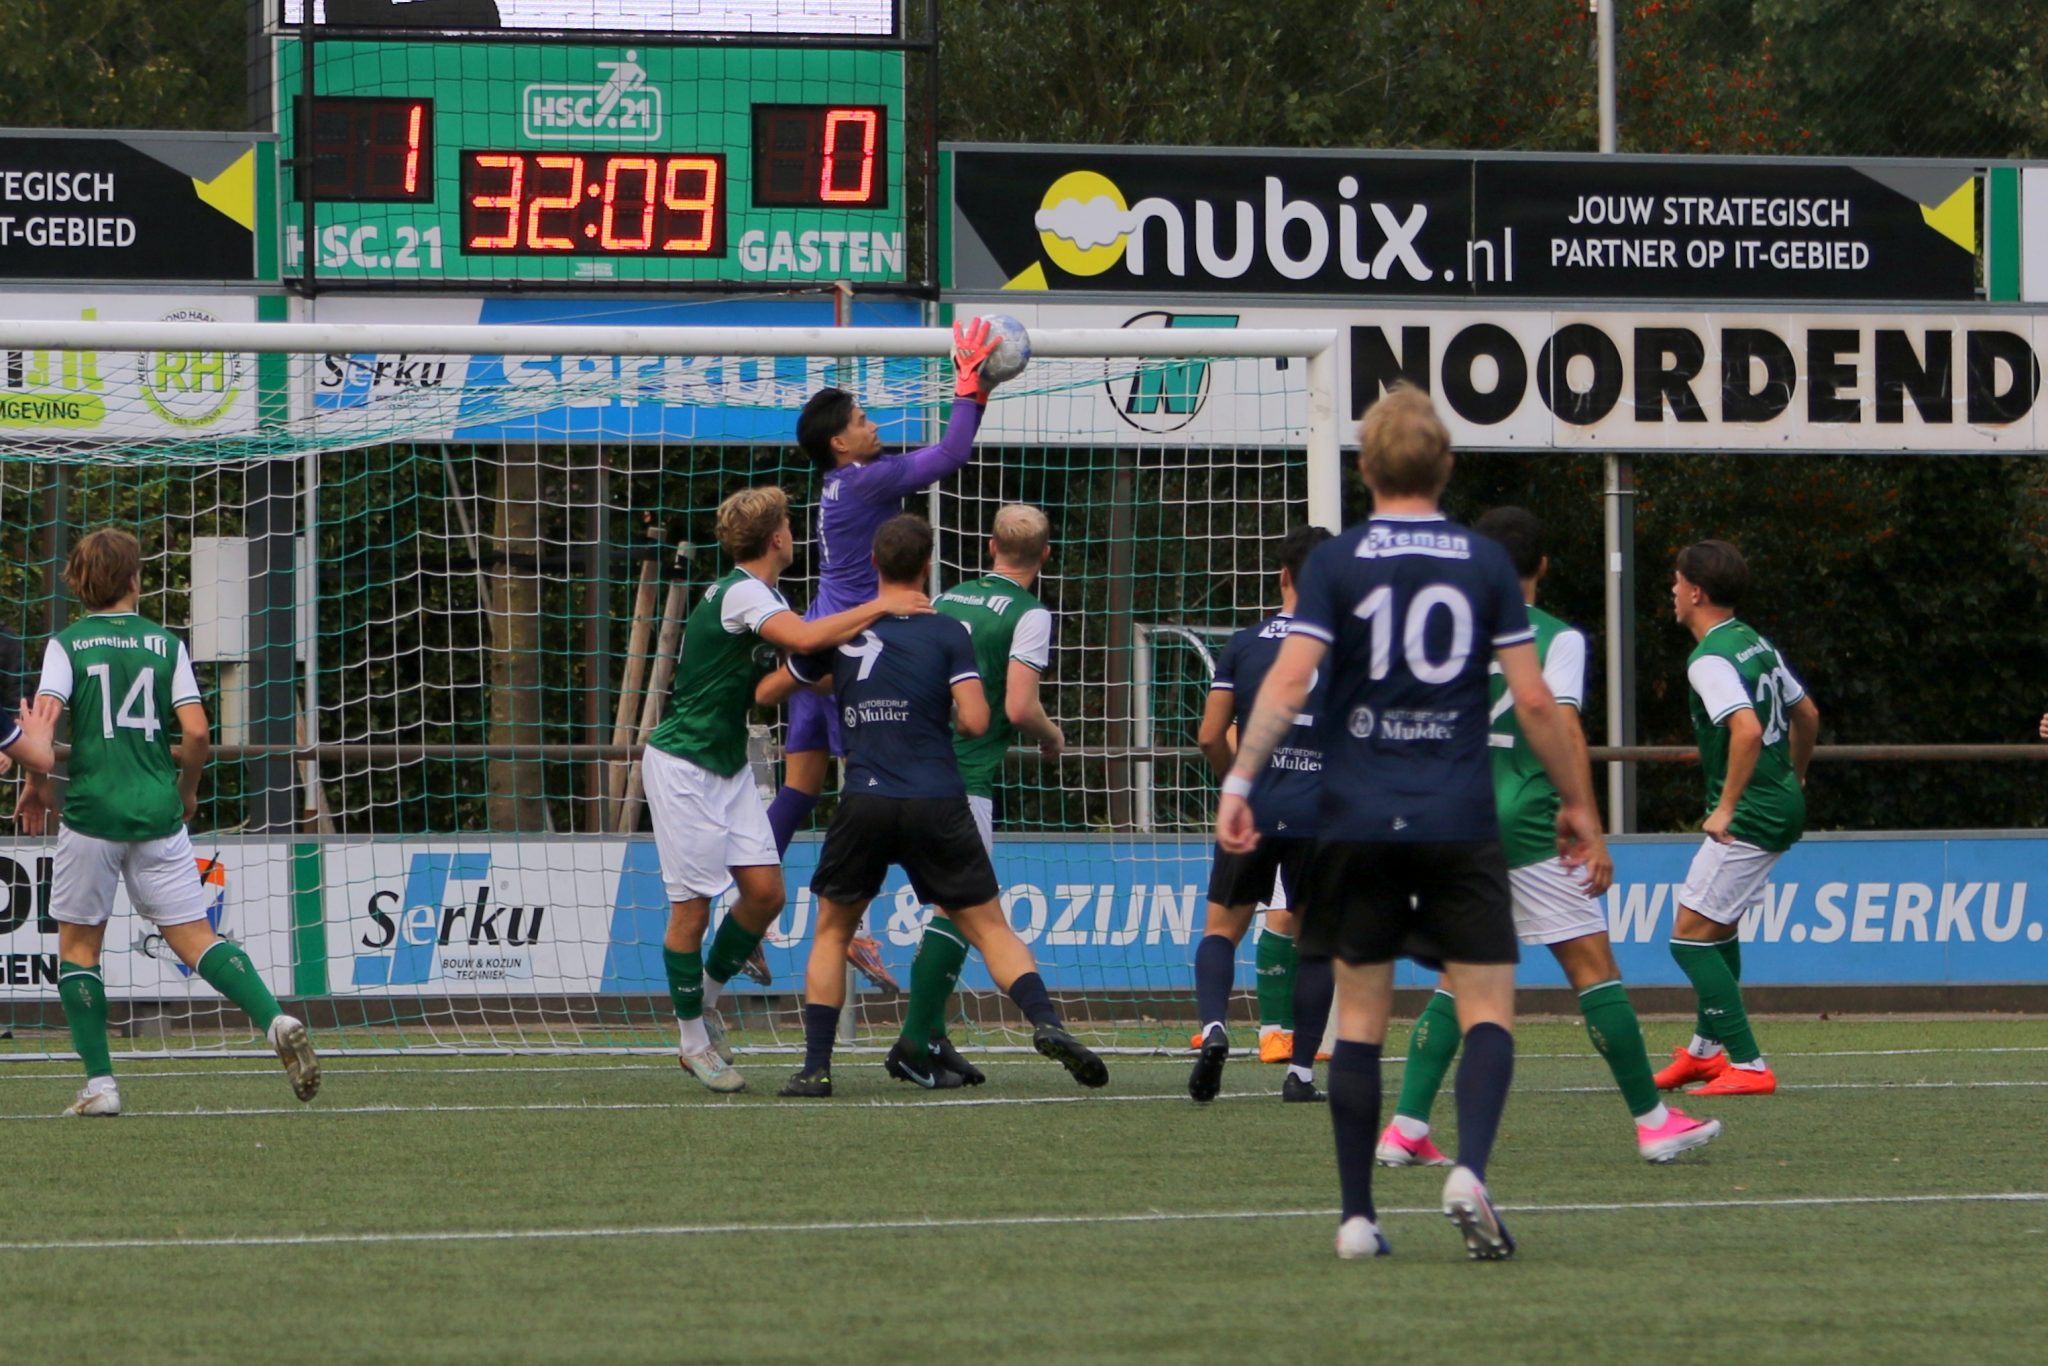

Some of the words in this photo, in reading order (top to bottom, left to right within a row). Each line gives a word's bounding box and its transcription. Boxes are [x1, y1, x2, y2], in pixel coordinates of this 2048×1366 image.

[403, 105, 423, 195] 1
[820, 109, 877, 203] 0
[0, 171, 115, 202] TEGISCH
[469, 155, 718, 252] 32:09
[1568, 195, 1655, 226] JOUW
[1663, 197, 1850, 229] STRATEGISCH
[286, 224, 443, 270] HSC.21
[737, 229, 902, 274] GASTEN
[1550, 239, 1678, 269] PARTNER
[1686, 240, 1726, 269] OP
[1734, 241, 1870, 271] IT-GEBIED
[1350, 322, 2042, 426] NOORDEND
[72, 636, 139, 652] Kormelink
[1353, 583, 1474, 685] 10
[86, 663, 161, 742] 14
[858, 708, 910, 723] Mulder
[362, 886, 544, 948] Serku
[997, 883, 1198, 947] OZIJN
[1606, 882, 2043, 944] WW.SERKU.
[442, 958, 474, 969] BOUW
[486, 958, 522, 969] KOZIJN
[456, 970, 506, 981] TECHNIEK
